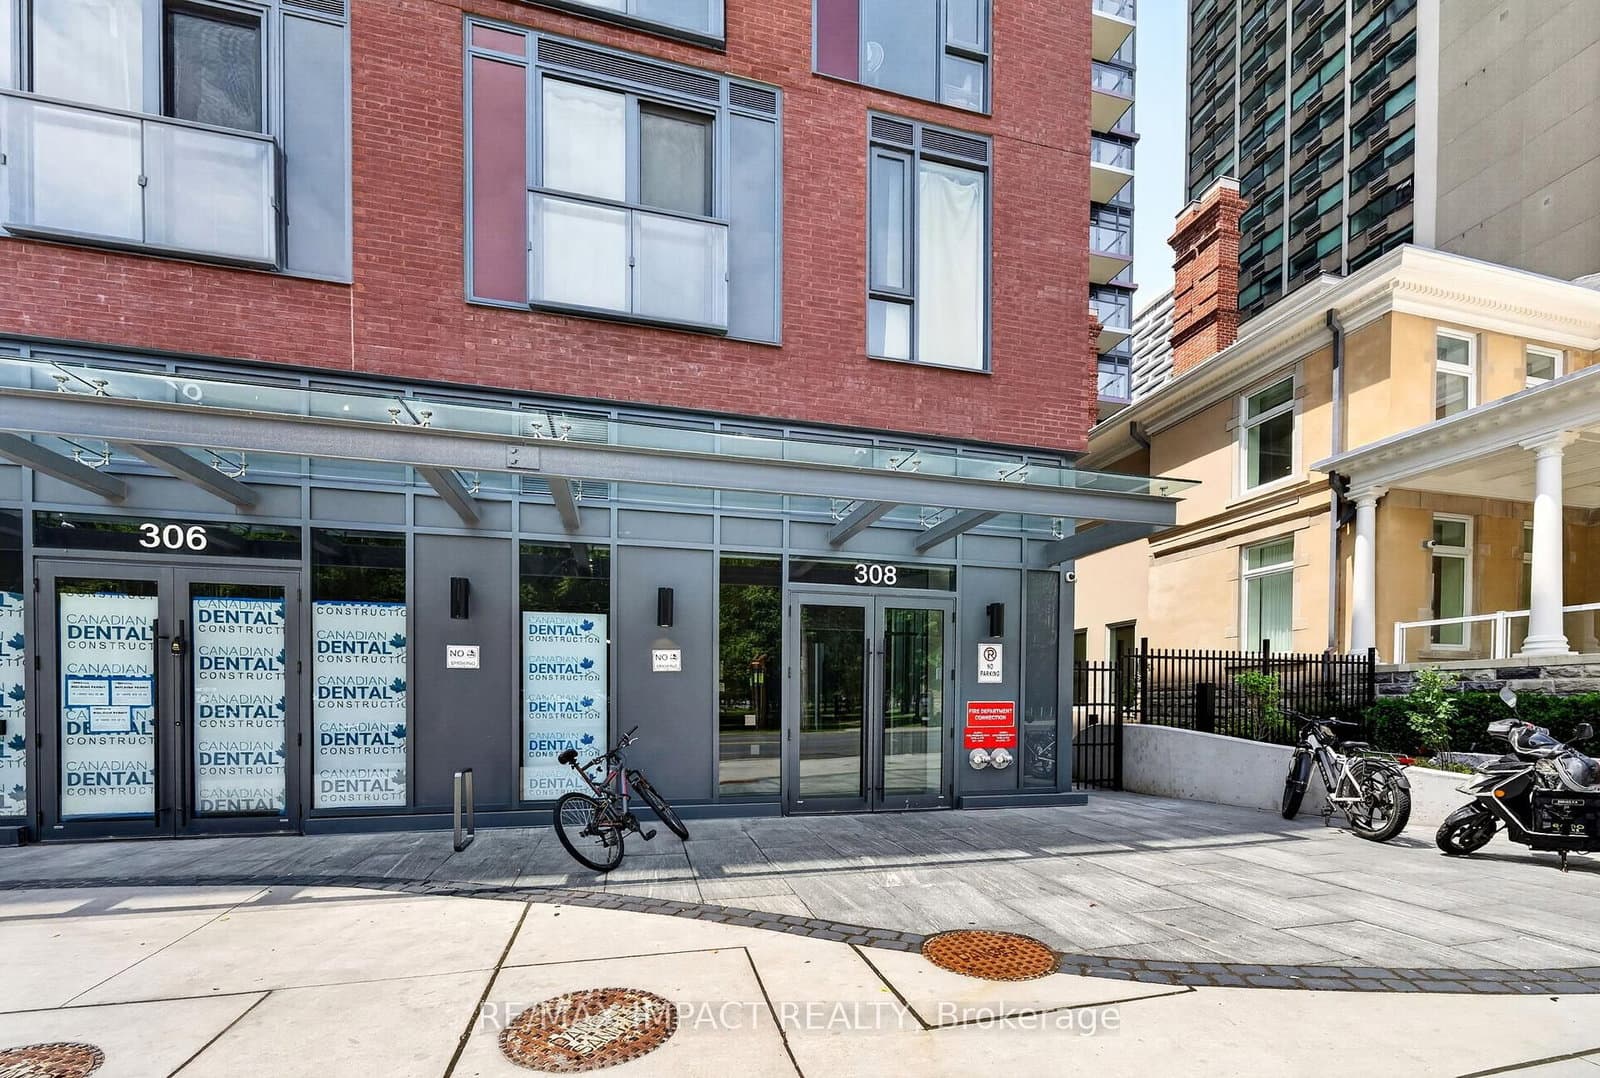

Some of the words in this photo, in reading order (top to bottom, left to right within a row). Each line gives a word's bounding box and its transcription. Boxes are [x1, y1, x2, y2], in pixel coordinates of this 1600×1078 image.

[139, 522, 208, 551] 306
[854, 563, 897, 585] 308
[197, 599, 273, 610] CANADIAN
[66, 613, 147, 626] CANADIAN
[198, 609, 279, 625] DENTAL
[67, 624, 153, 641] DENTAL
[316, 630, 387, 641] CANADIAN
[528, 624, 582, 636] DENTAL
[528, 634, 600, 644] CONSTRUCTION
[198, 645, 274, 657] CANADIAN
[317, 640, 393, 655] DENTAL
[655, 653, 668, 661] NO
[67, 662, 147, 674] CANADIAN
[199, 656, 280, 671] DENTAL
[529, 663, 582, 675] DENTAL
[317, 675, 388, 686] CANADIAN
[528, 673, 600, 682] CONSTRUCTION
[318, 685, 393, 700] DENTAL
[199, 693, 273, 705] CANADIAN
[199, 704, 280, 719] DENTAL
[529, 701, 582, 713] DENTAL
[528, 711, 600, 720] CONSTRUCTION
[66, 720, 153, 736] DEAL
[319, 722, 390, 733] CANADIAN
[320, 732, 395, 747] DENTAL
[529, 739, 582, 751] DENTAL
[198, 741, 274, 752] CANADIAN
[199, 751, 280, 766] DENTAL
[66, 760, 147, 772] CANADIAN
[67, 771, 154, 787] DENTAL
[319, 768, 391, 780] CANADIAN
[320, 779, 395, 793] DENTAL
[529, 777, 583, 789] DENTAL
[199, 788, 274, 799] CANADIAN
[200, 798, 279, 812] DENTAL
